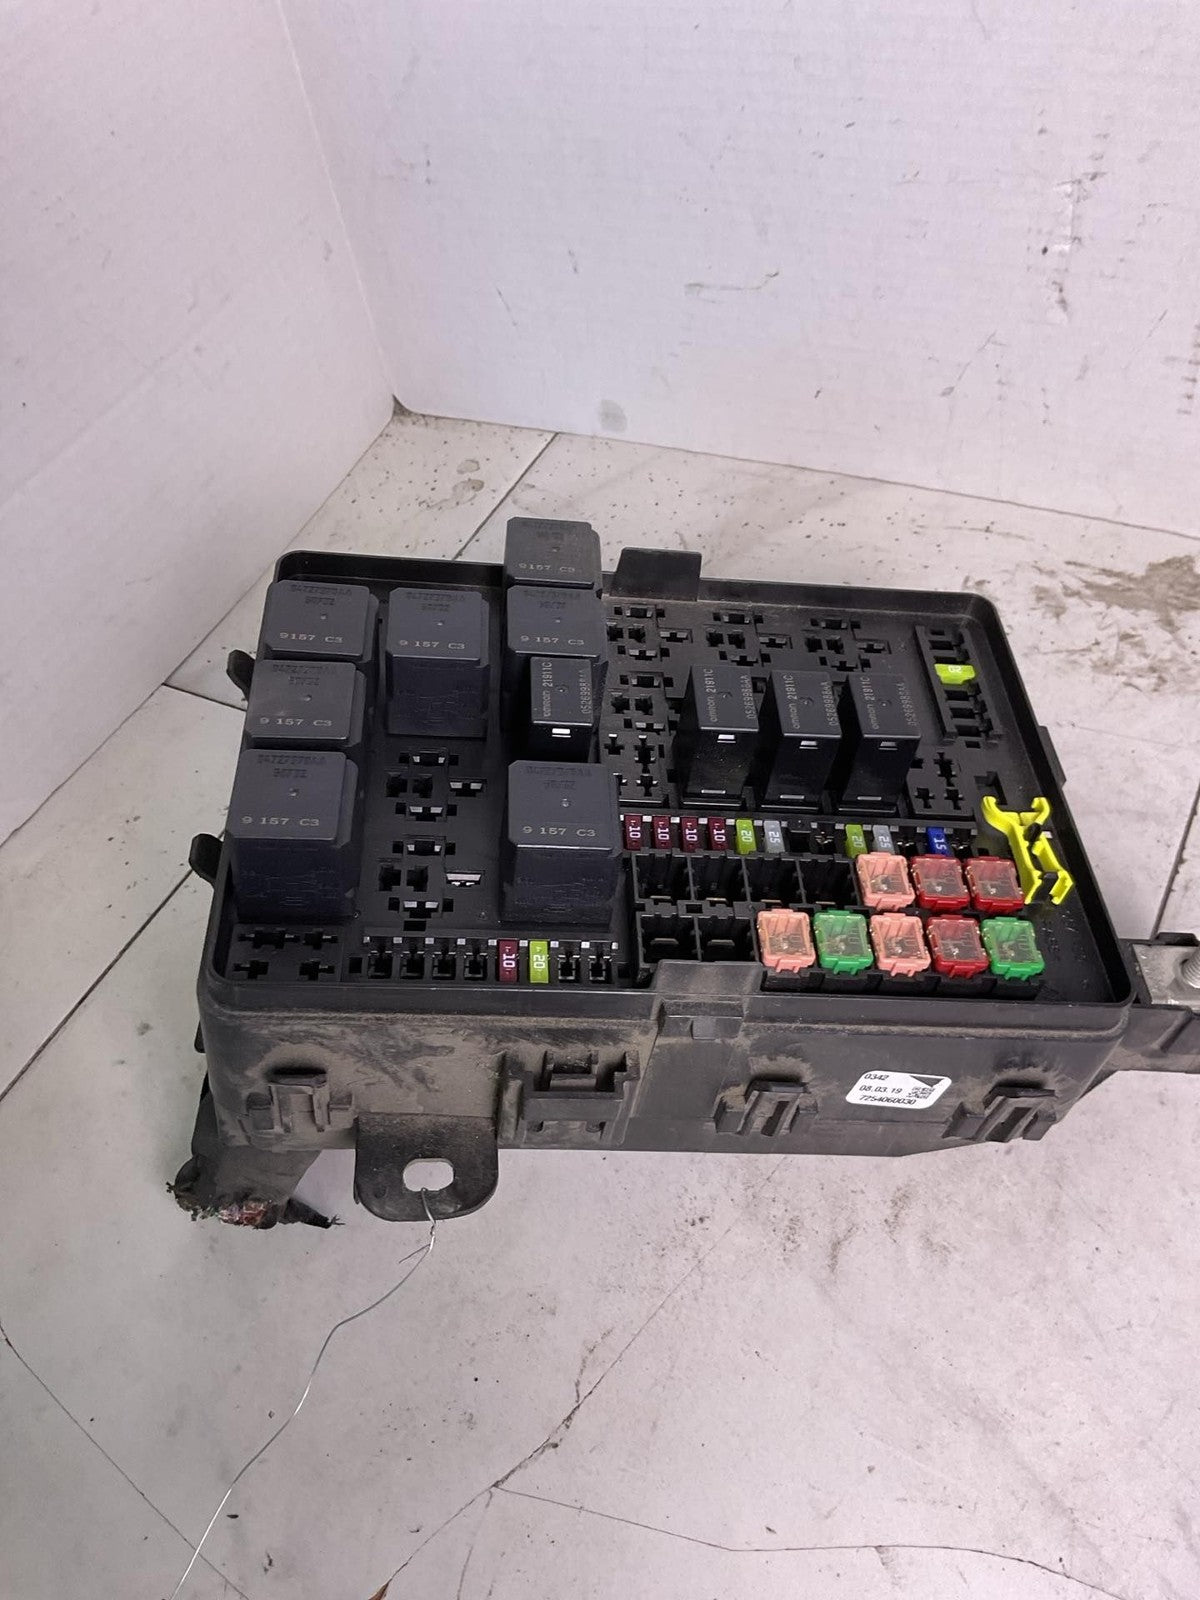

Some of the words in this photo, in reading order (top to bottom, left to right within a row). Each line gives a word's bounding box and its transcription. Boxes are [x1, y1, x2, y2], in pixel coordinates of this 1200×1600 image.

[299, 818, 320, 826] C3
[576, 828, 596, 837] C3
[629, 826, 641, 838] 10
[658, 827, 669, 840] 10
[686, 828, 698, 841] 10
[713, 829, 726, 842] 10
[741, 830, 752, 842] 20
[768, 831, 781, 844] 25
[852, 835, 863, 848] 20
[878, 836, 891, 848] 25
[934, 838, 947, 850] 15
[503, 953, 516, 968] 10
[533, 954, 546, 969] 20
[864, 1073, 889, 1081] 0342
